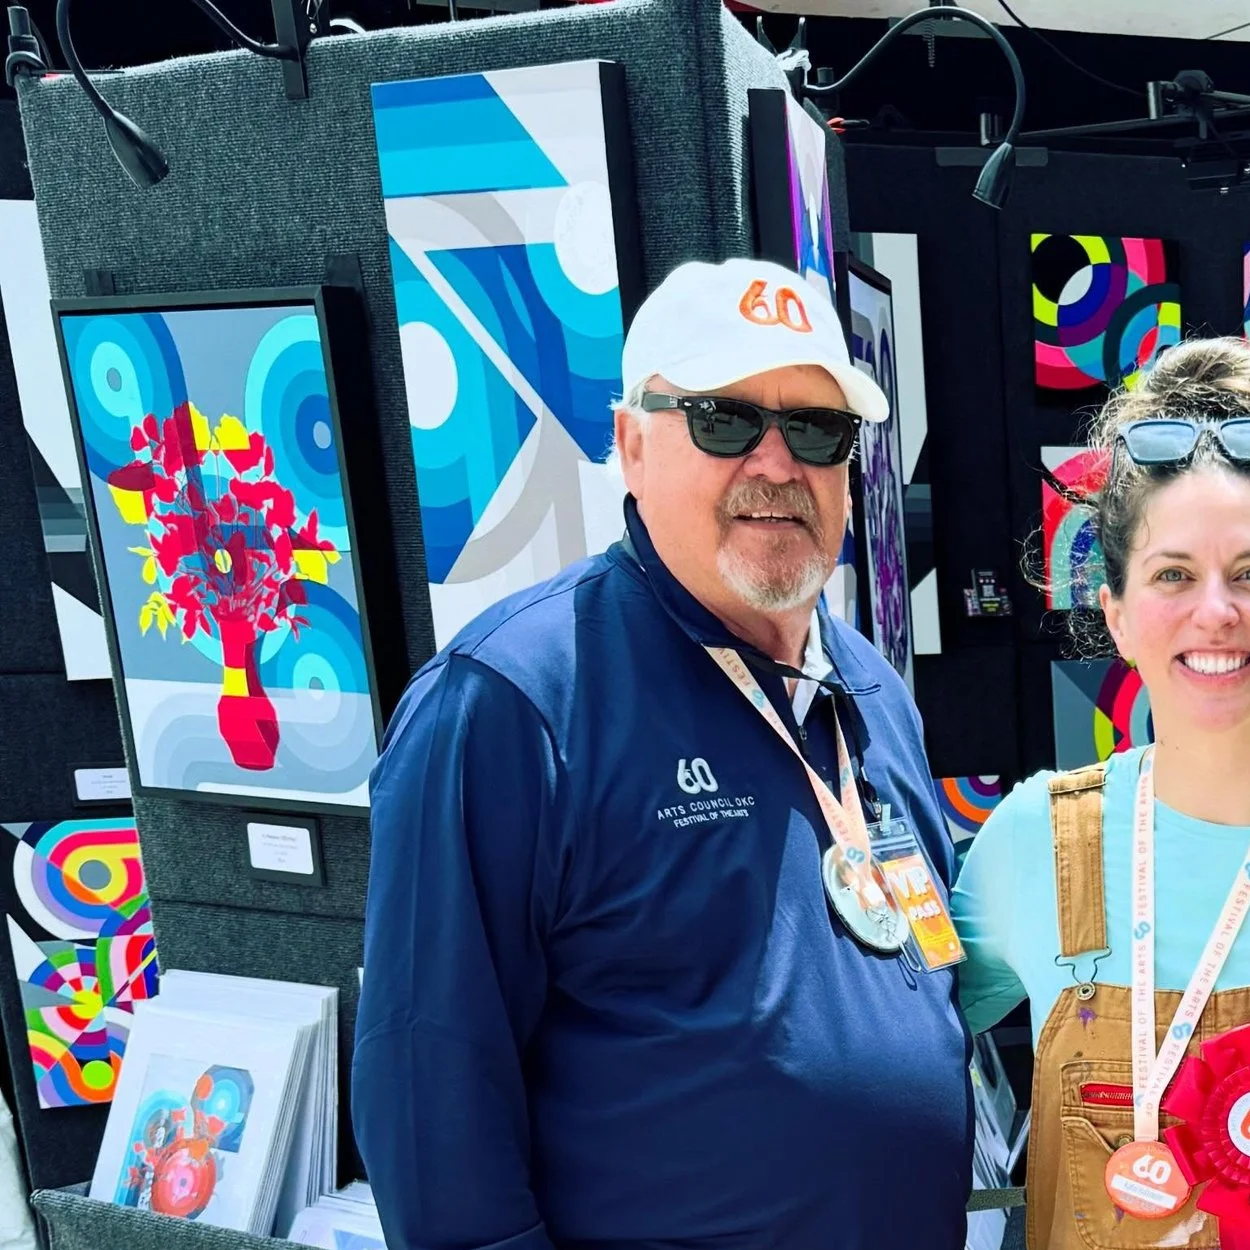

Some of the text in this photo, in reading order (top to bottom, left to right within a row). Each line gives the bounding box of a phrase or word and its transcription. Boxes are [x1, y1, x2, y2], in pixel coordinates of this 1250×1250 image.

[739, 279, 814, 333] 60
[677, 758, 719, 794] 60
[657, 796, 755, 820] ARTS COUNCIL OKC
[673, 813, 710, 828] FESTIVAL
[709, 811, 719, 820] OF
[1139, 811, 1148, 832] THE
[1138, 841, 1147, 854] OF
[1138, 861, 1147, 916] FESTIVAL
[1138, 944, 1147, 974] ARTS
[1214, 942, 1226, 957] OF
[1200, 962, 1217, 984] THE
[1138, 981, 1147, 1005] THE
[1185, 988, 1204, 1018] ARTS
[1138, 1011, 1147, 1024] OF
[1138, 1030, 1148, 1088] FESTIVAL
[1132, 1154, 1172, 1185] 60
